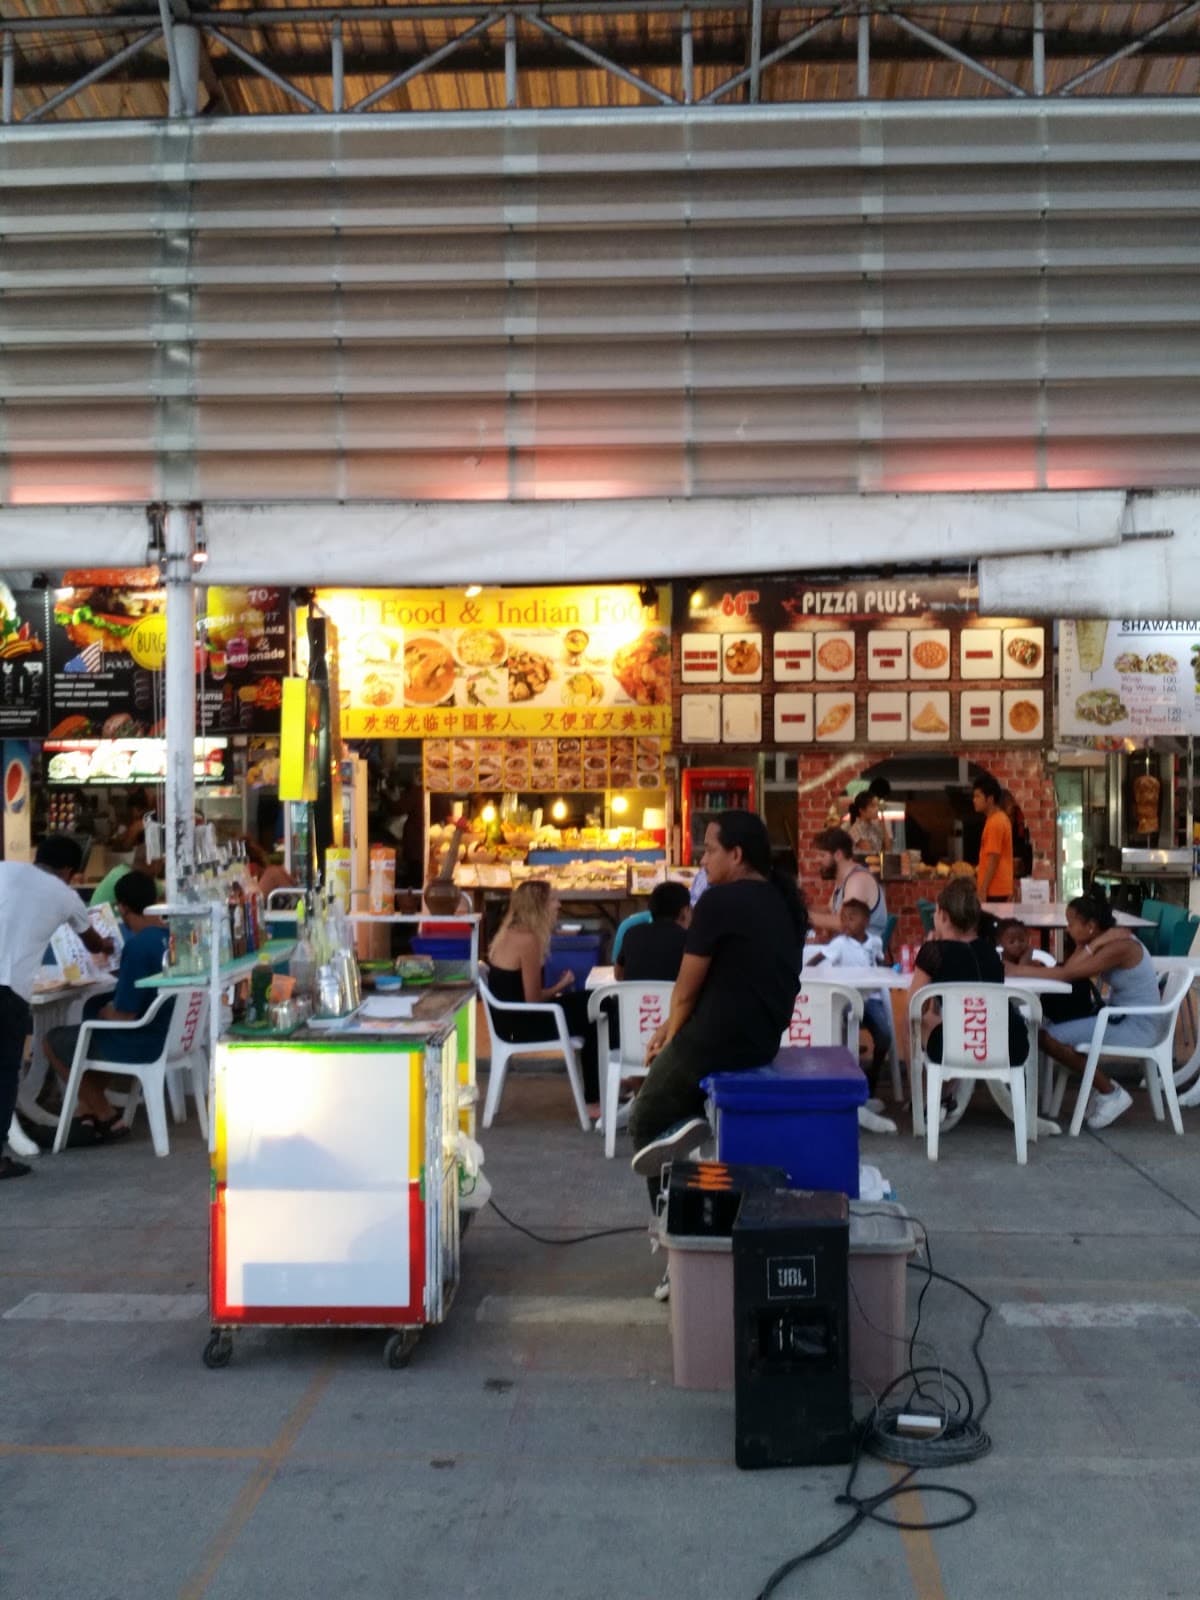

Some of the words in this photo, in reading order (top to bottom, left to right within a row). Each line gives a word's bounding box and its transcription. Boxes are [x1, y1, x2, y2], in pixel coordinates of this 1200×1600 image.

[381, 600, 446, 625] Food
[459, 600, 483, 625] &
[496, 600, 580, 624] Indian
[803, 592, 858, 614] PIZZA
[1121, 619, 1200, 632] SHAWARM
[137, 632, 166, 653] BURG
[224, 649, 285, 665] Lemonade
[789, 1005, 812, 1049] FP
[777, 1268, 807, 1287] JBL
